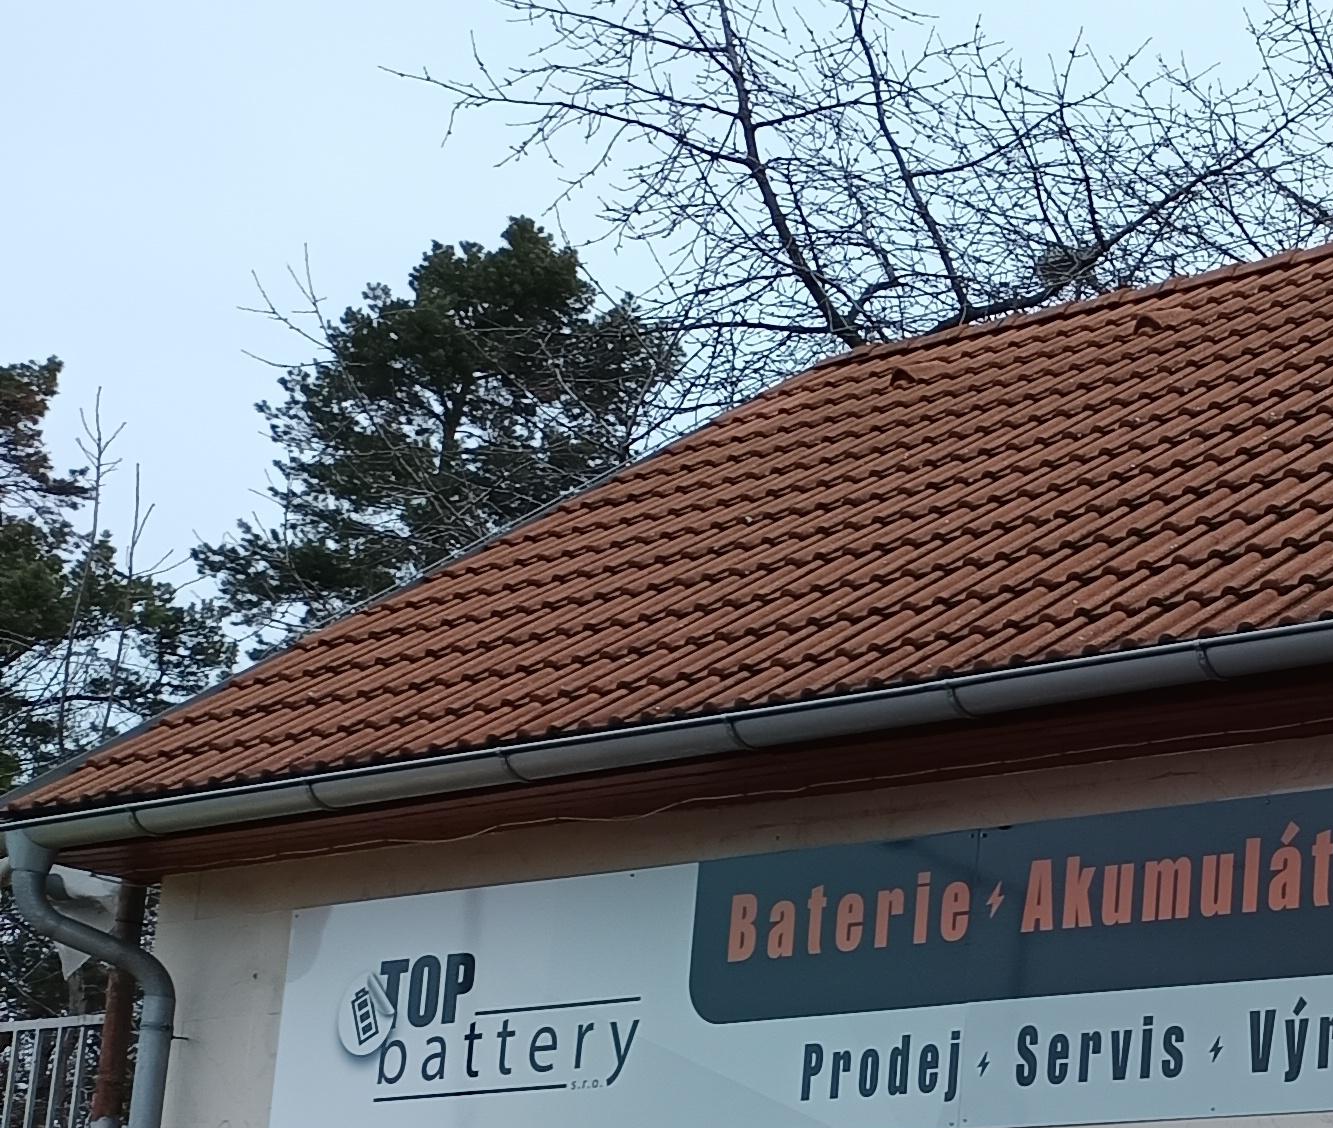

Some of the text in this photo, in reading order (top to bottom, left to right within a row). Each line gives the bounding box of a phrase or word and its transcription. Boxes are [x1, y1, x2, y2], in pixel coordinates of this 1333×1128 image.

[727, 871, 973, 964] Baterie
[380, 952, 476, 1029] TOP
[376, 1018, 640, 1087] battery
[570, 1078, 605, 1091] s.r.o.
[800, 1029, 962, 1102] Prodej
[1015, 1015, 1185, 1088] Servis
